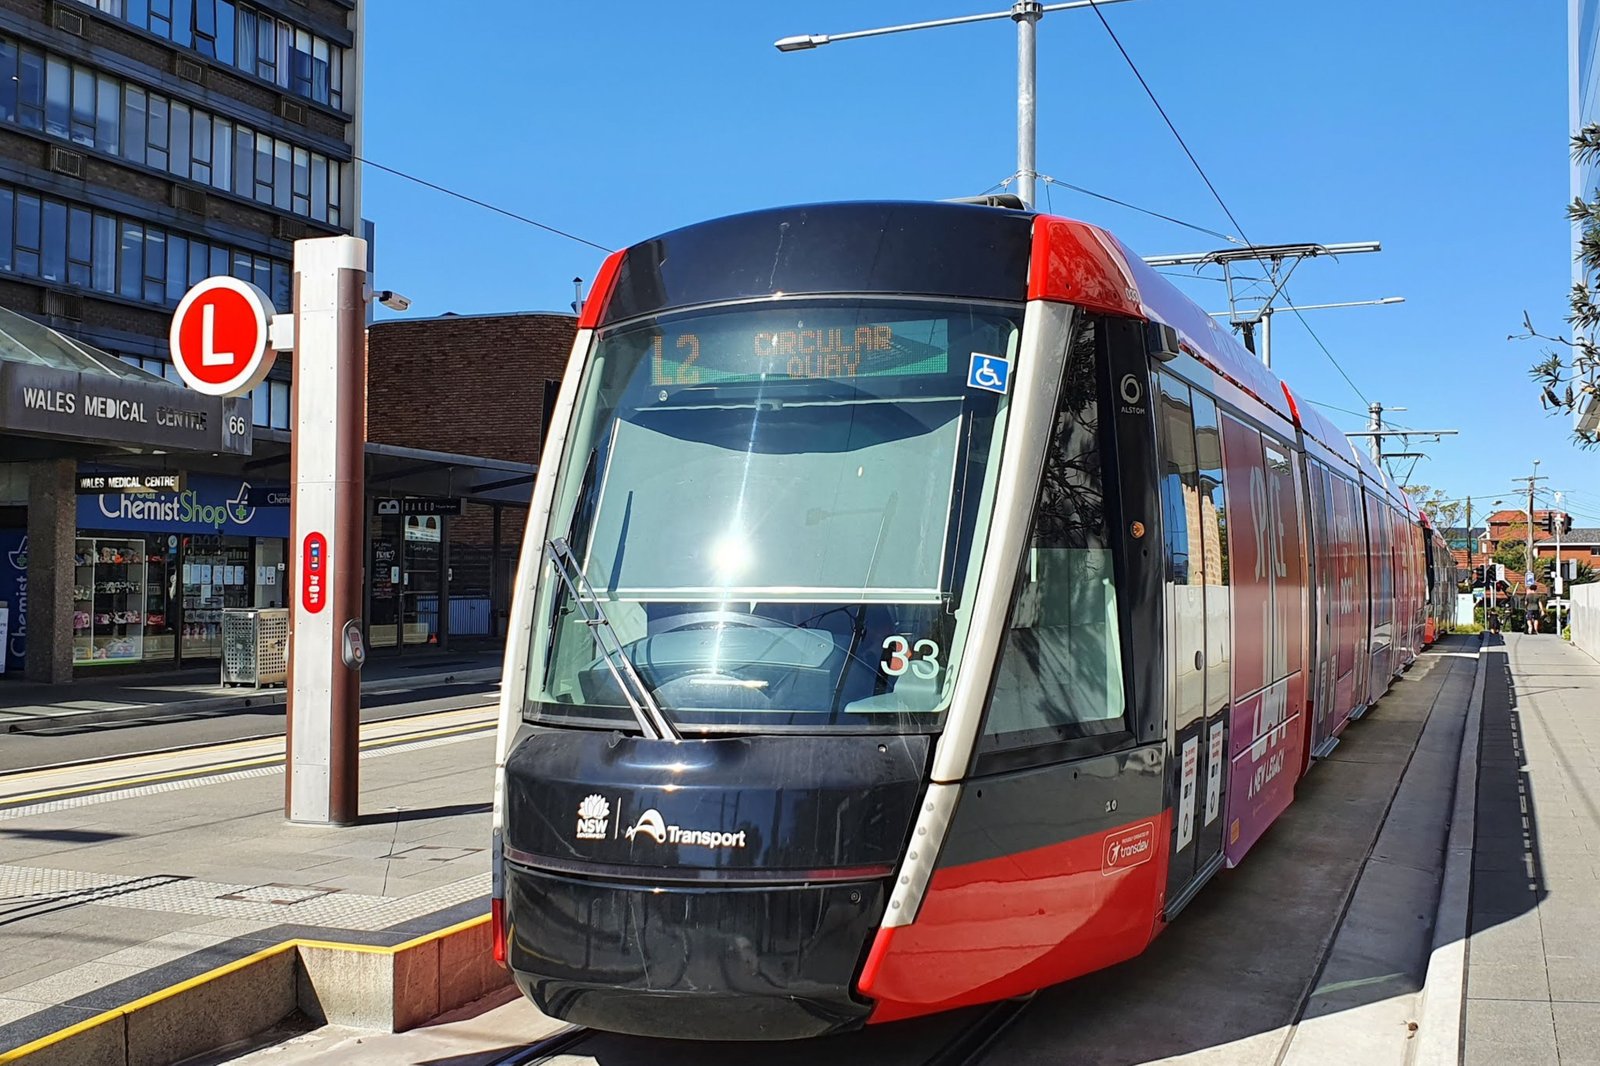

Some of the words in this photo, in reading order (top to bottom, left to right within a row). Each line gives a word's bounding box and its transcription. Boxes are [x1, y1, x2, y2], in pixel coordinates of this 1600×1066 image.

[202, 303, 234, 366] L
[754, 325, 892, 356] CIRCULAR
[653, 335, 699, 385] L2
[23, 387, 76, 414] WALES
[84, 395, 148, 423] MEDICAL
[155, 406, 207, 431] CENTRE
[1121, 406, 1145, 415] ALSTOM
[229, 416, 245, 435] 66
[80, 477, 105, 488] WALES
[108, 477, 141, 488] MEDICAL
[144, 475, 175, 487] CENTRE
[405, 502, 434, 511] BAKED
[10, 576, 27, 657] Chemist
[881, 635, 939, 679] 33
[577, 818, 608, 833] NSW
[667, 826, 747, 848] Transport
[1120, 839, 1149, 858] transdev
